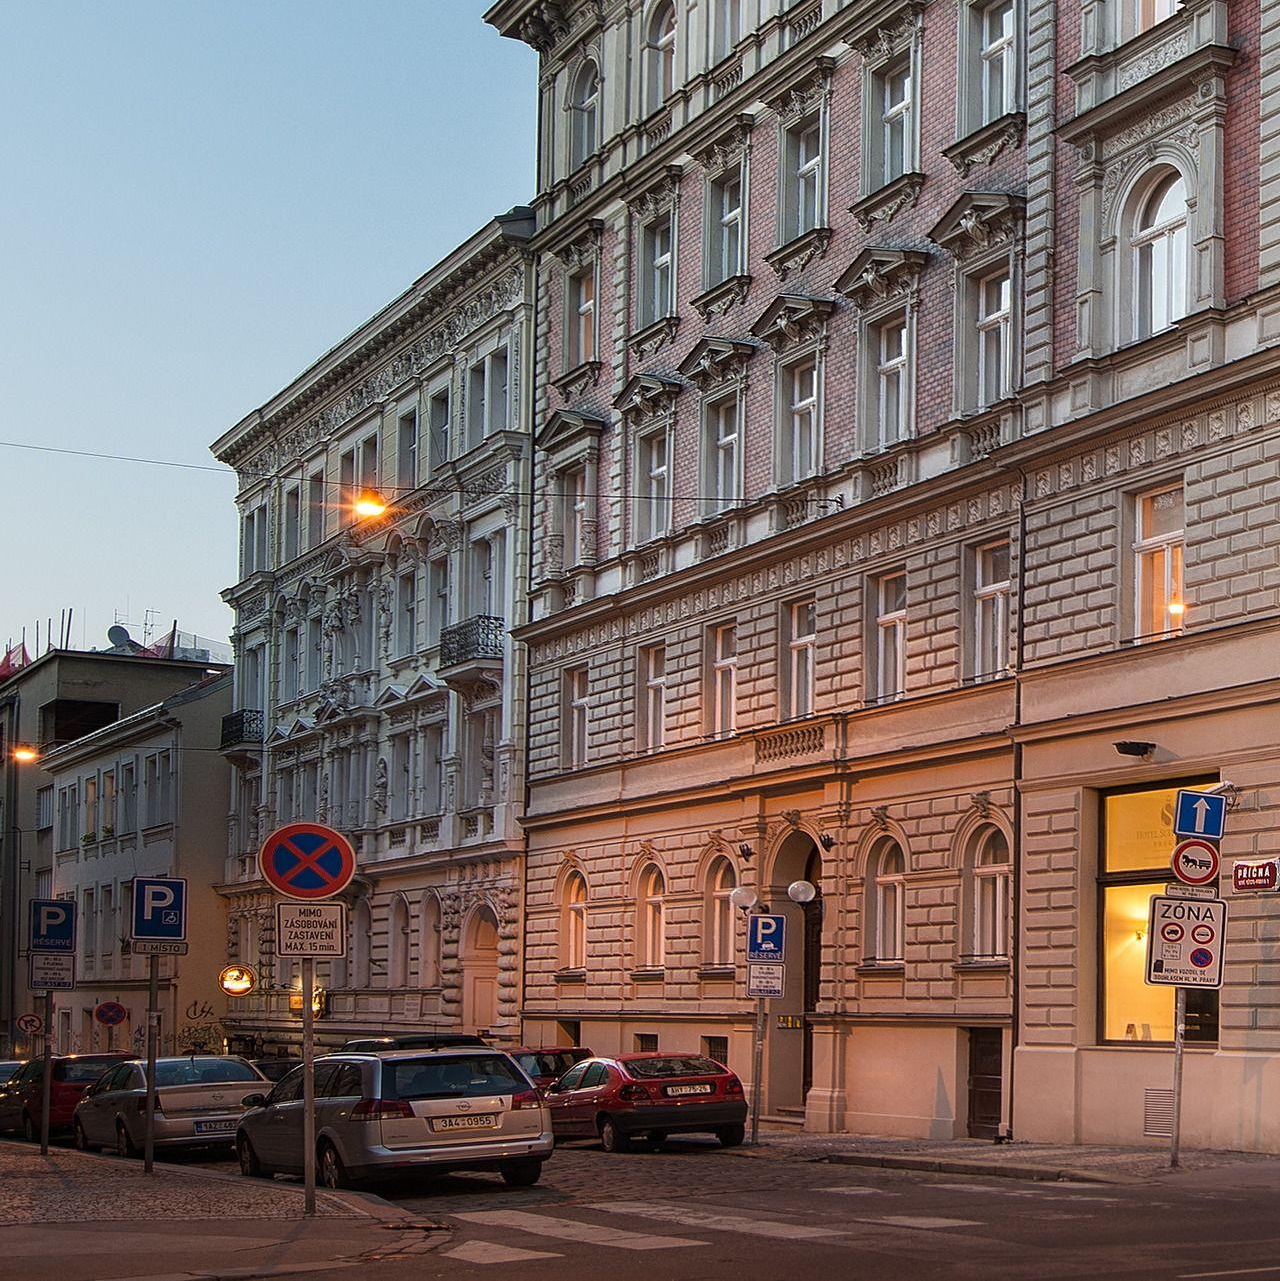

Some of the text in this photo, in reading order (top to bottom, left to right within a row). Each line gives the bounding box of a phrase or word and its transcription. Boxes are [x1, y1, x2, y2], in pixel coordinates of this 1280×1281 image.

[144, 885, 174, 920] P
[299, 908, 322, 918] MIMO
[1161, 902, 1215, 922] ZÓNA
[40, 906, 66, 935] P
[284, 918, 338, 929] ZÁSOBOVÁNÍ
[288, 930, 334, 940] ZASTAVENÍ
[756, 917, 777, 944] P
[151, 942, 180, 952] MÍSTO
[285, 942, 337, 951] MAX. 15 min.
[441, 1116, 492, 1128] 3A4 0955
